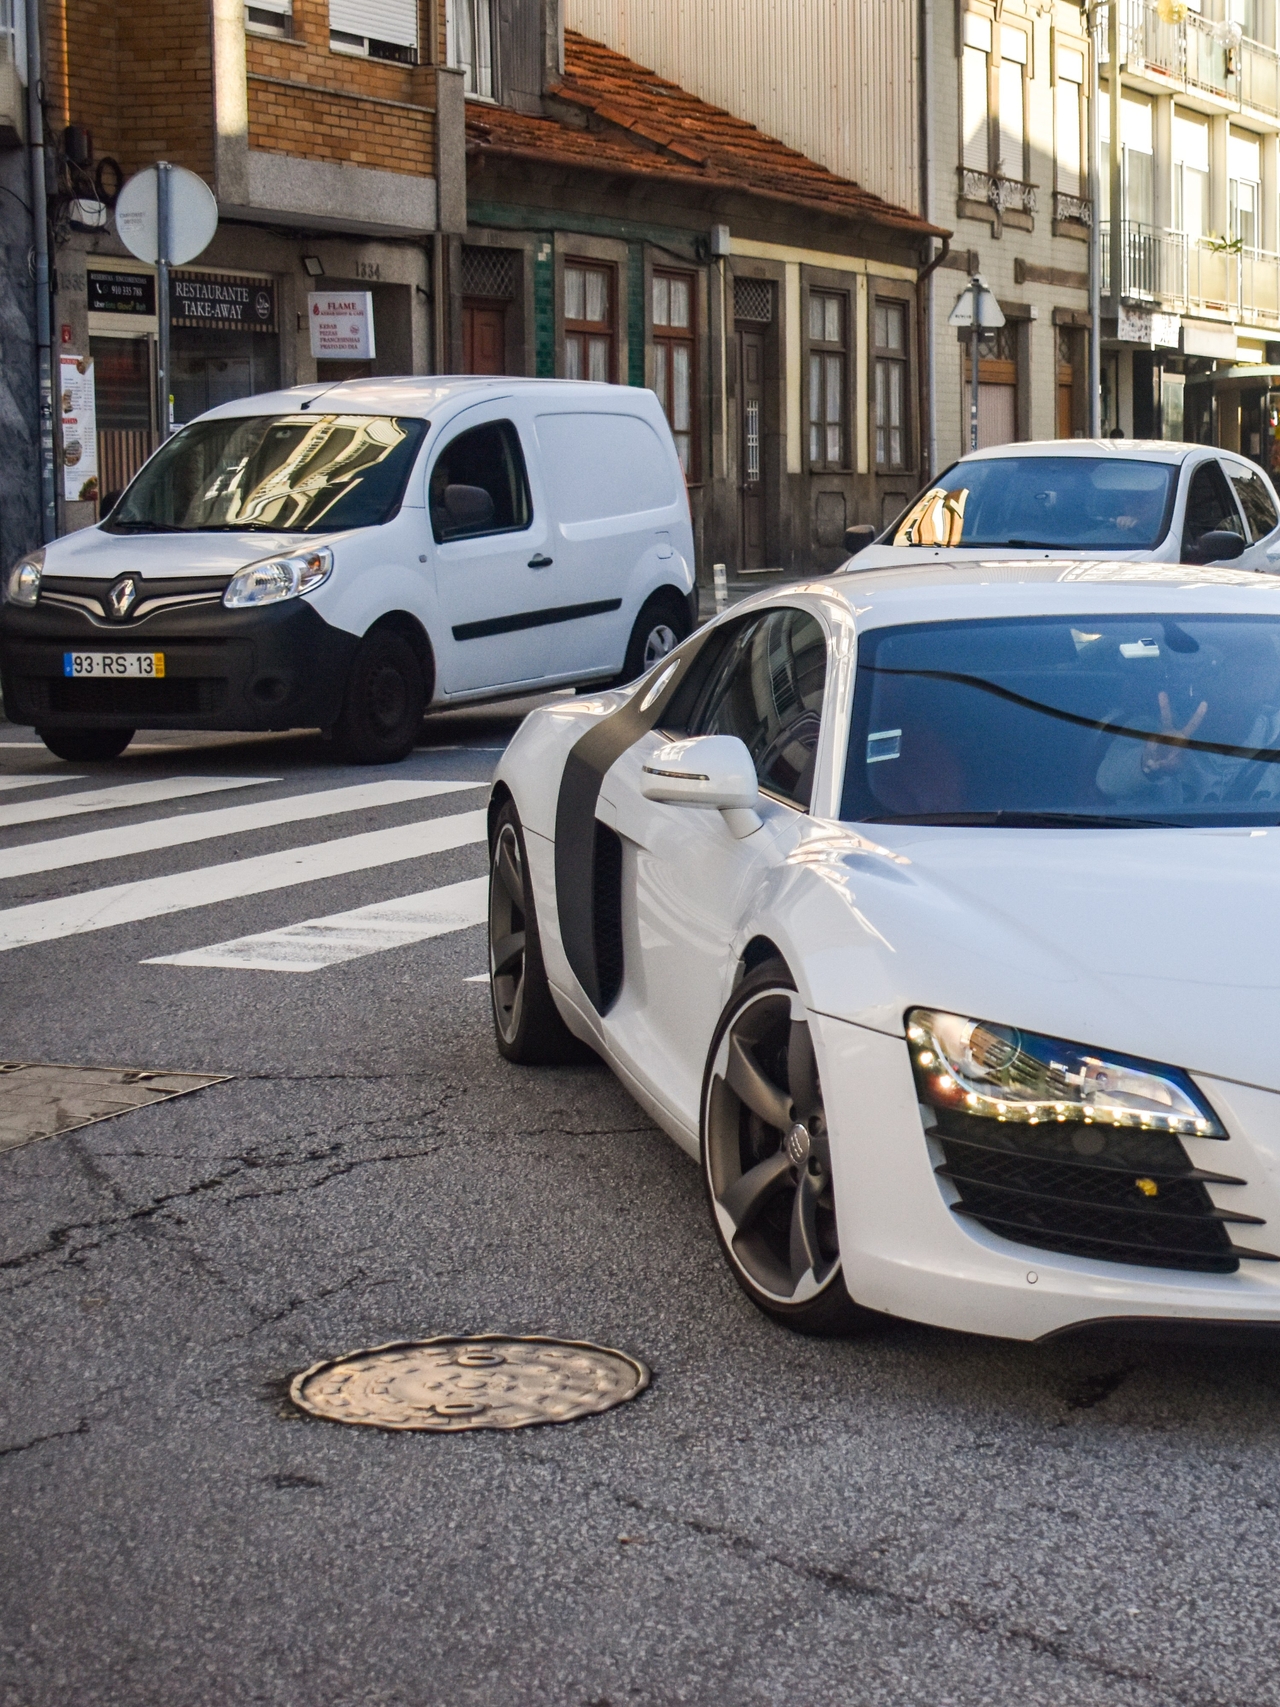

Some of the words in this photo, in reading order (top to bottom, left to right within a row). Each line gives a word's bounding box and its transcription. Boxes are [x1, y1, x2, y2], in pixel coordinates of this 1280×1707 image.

[355, 261, 380, 280] 1334
[111, 285, 121, 295] 910
[122, 286, 132, 296] 335
[175, 281, 250, 302] RESTAURANTE
[94, 301, 105, 309] Uber
[182, 300, 243, 320] TAKE-AWAY
[327, 302, 357, 310] FLAME
